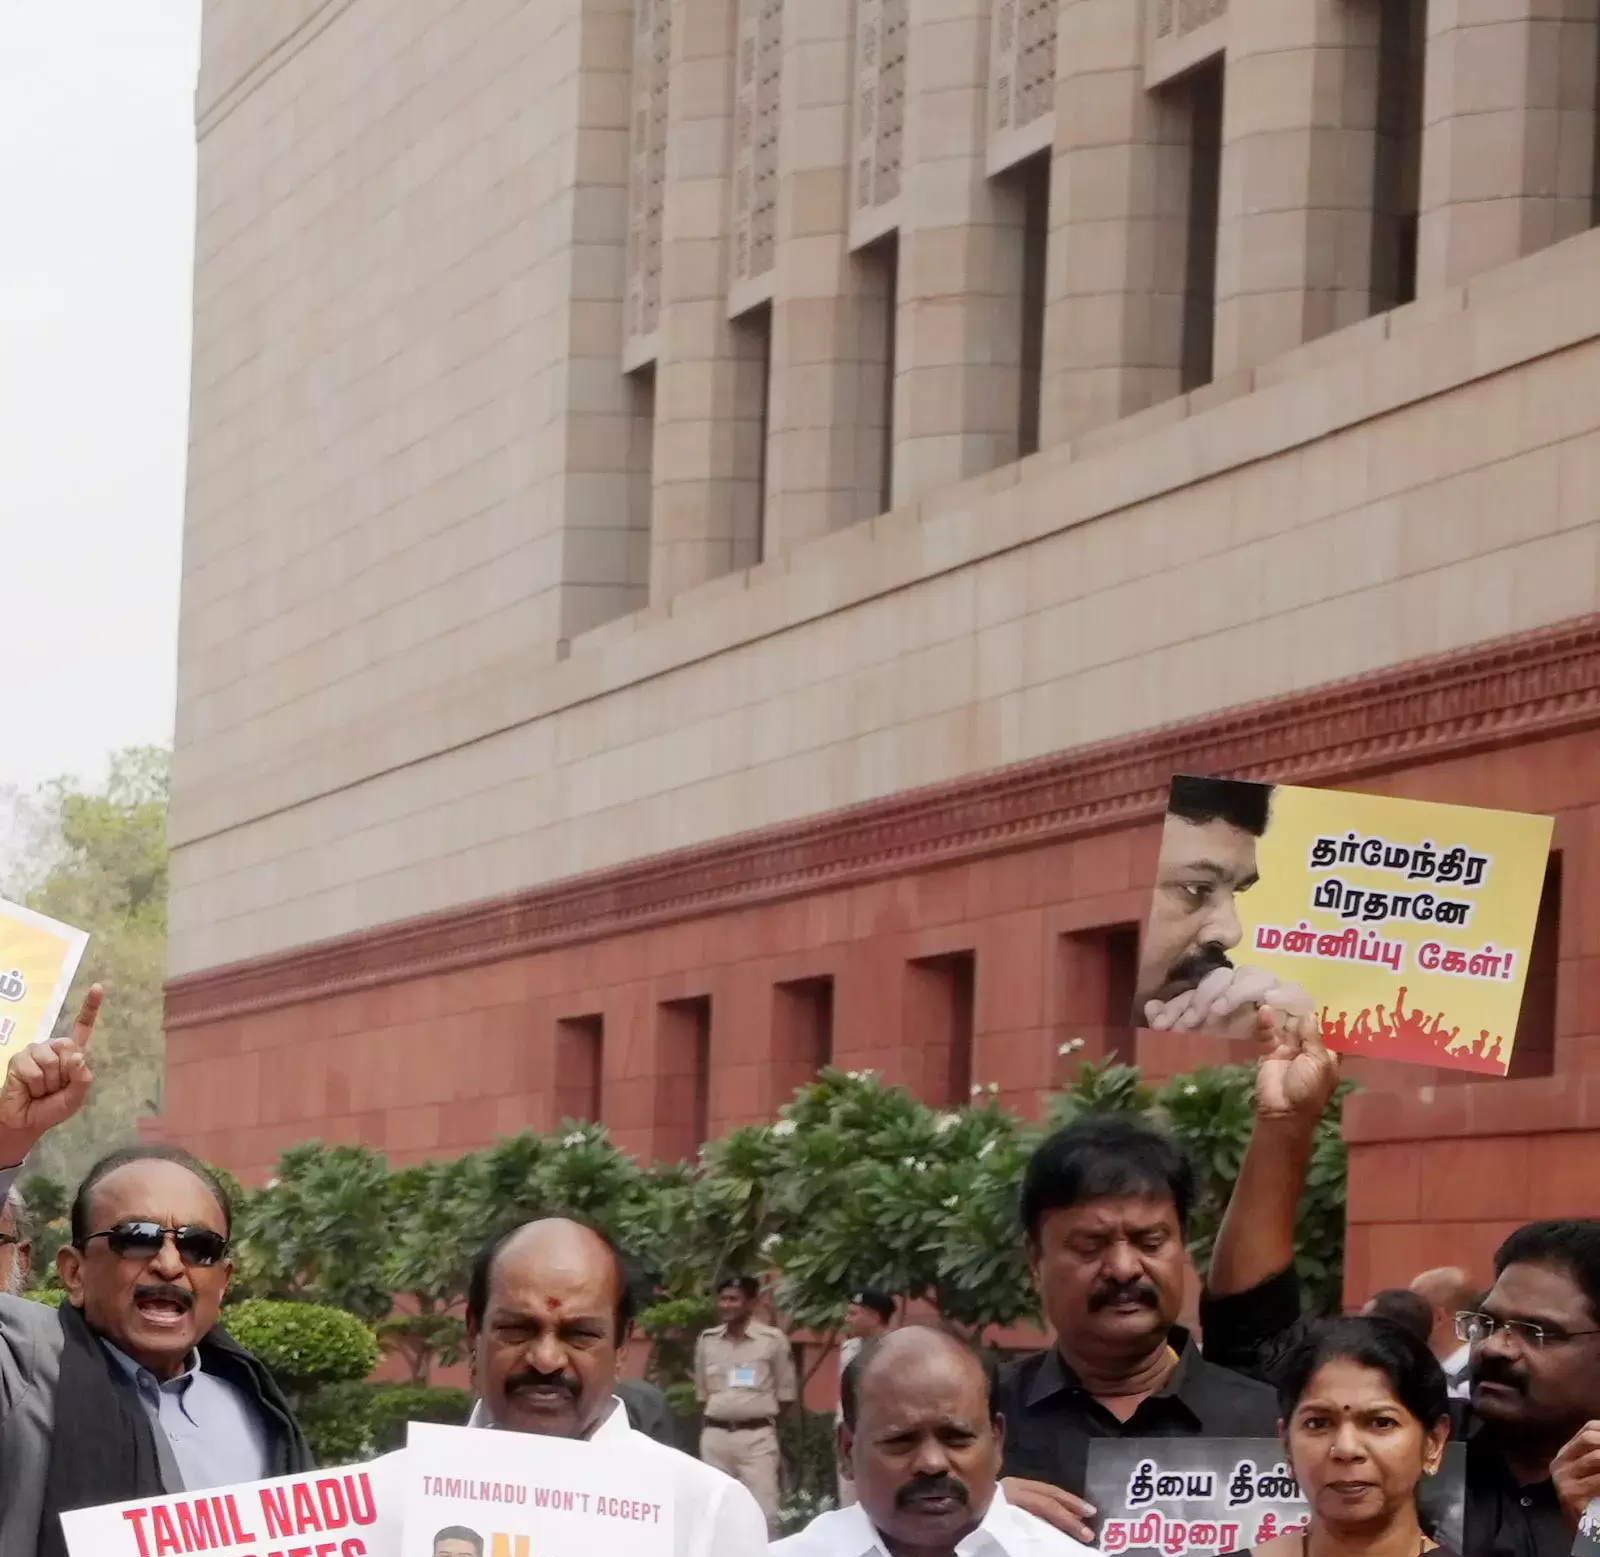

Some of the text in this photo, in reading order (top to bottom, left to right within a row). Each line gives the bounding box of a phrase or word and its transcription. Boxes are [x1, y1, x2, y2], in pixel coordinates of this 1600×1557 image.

[1311, 834, 1487, 885] தர்மேந்திர
[1314, 879, 1470, 925] பிரதானே
[1256, 922, 1513, 979] மன்னிப்பு கேள்!
[259, 1472, 378, 1540] NADU
[423, 1475, 527, 1505] TAMILNADU
[596, 1498, 661, 1524] ACCEPT
[1130, 1463, 1213, 1505] தீயை
[1104, 1513, 1239, 1555] தமிழரை
